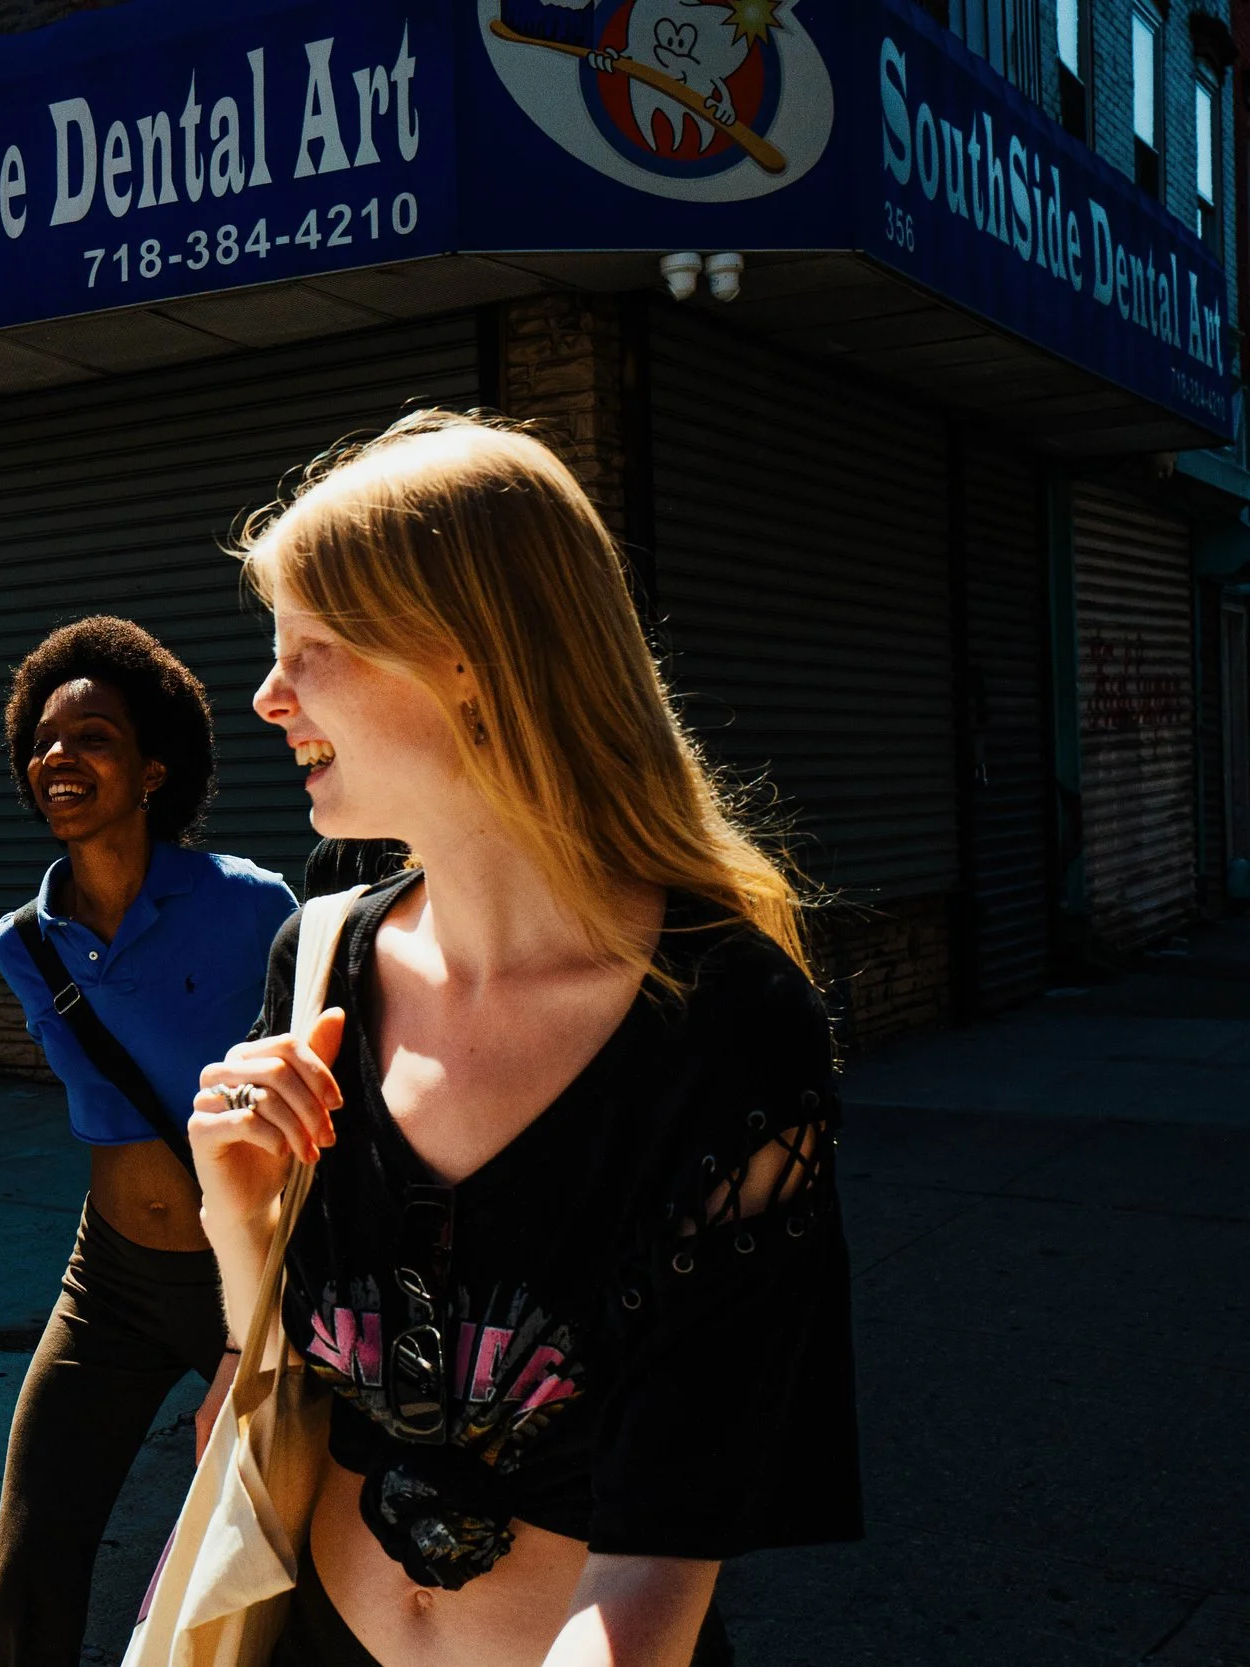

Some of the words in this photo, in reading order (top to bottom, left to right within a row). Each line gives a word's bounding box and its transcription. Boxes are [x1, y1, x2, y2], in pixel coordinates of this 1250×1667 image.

[48, 47, 273, 227] Dental
[293, 17, 420, 179] Art
[83, 192, 419, 289] 718-384-4210
[881, 36, 1083, 292] SouthSide
[1088, 199, 1181, 350] Dental
[1187, 271, 1225, 377] Art
[883, 200, 916, 254] 356
